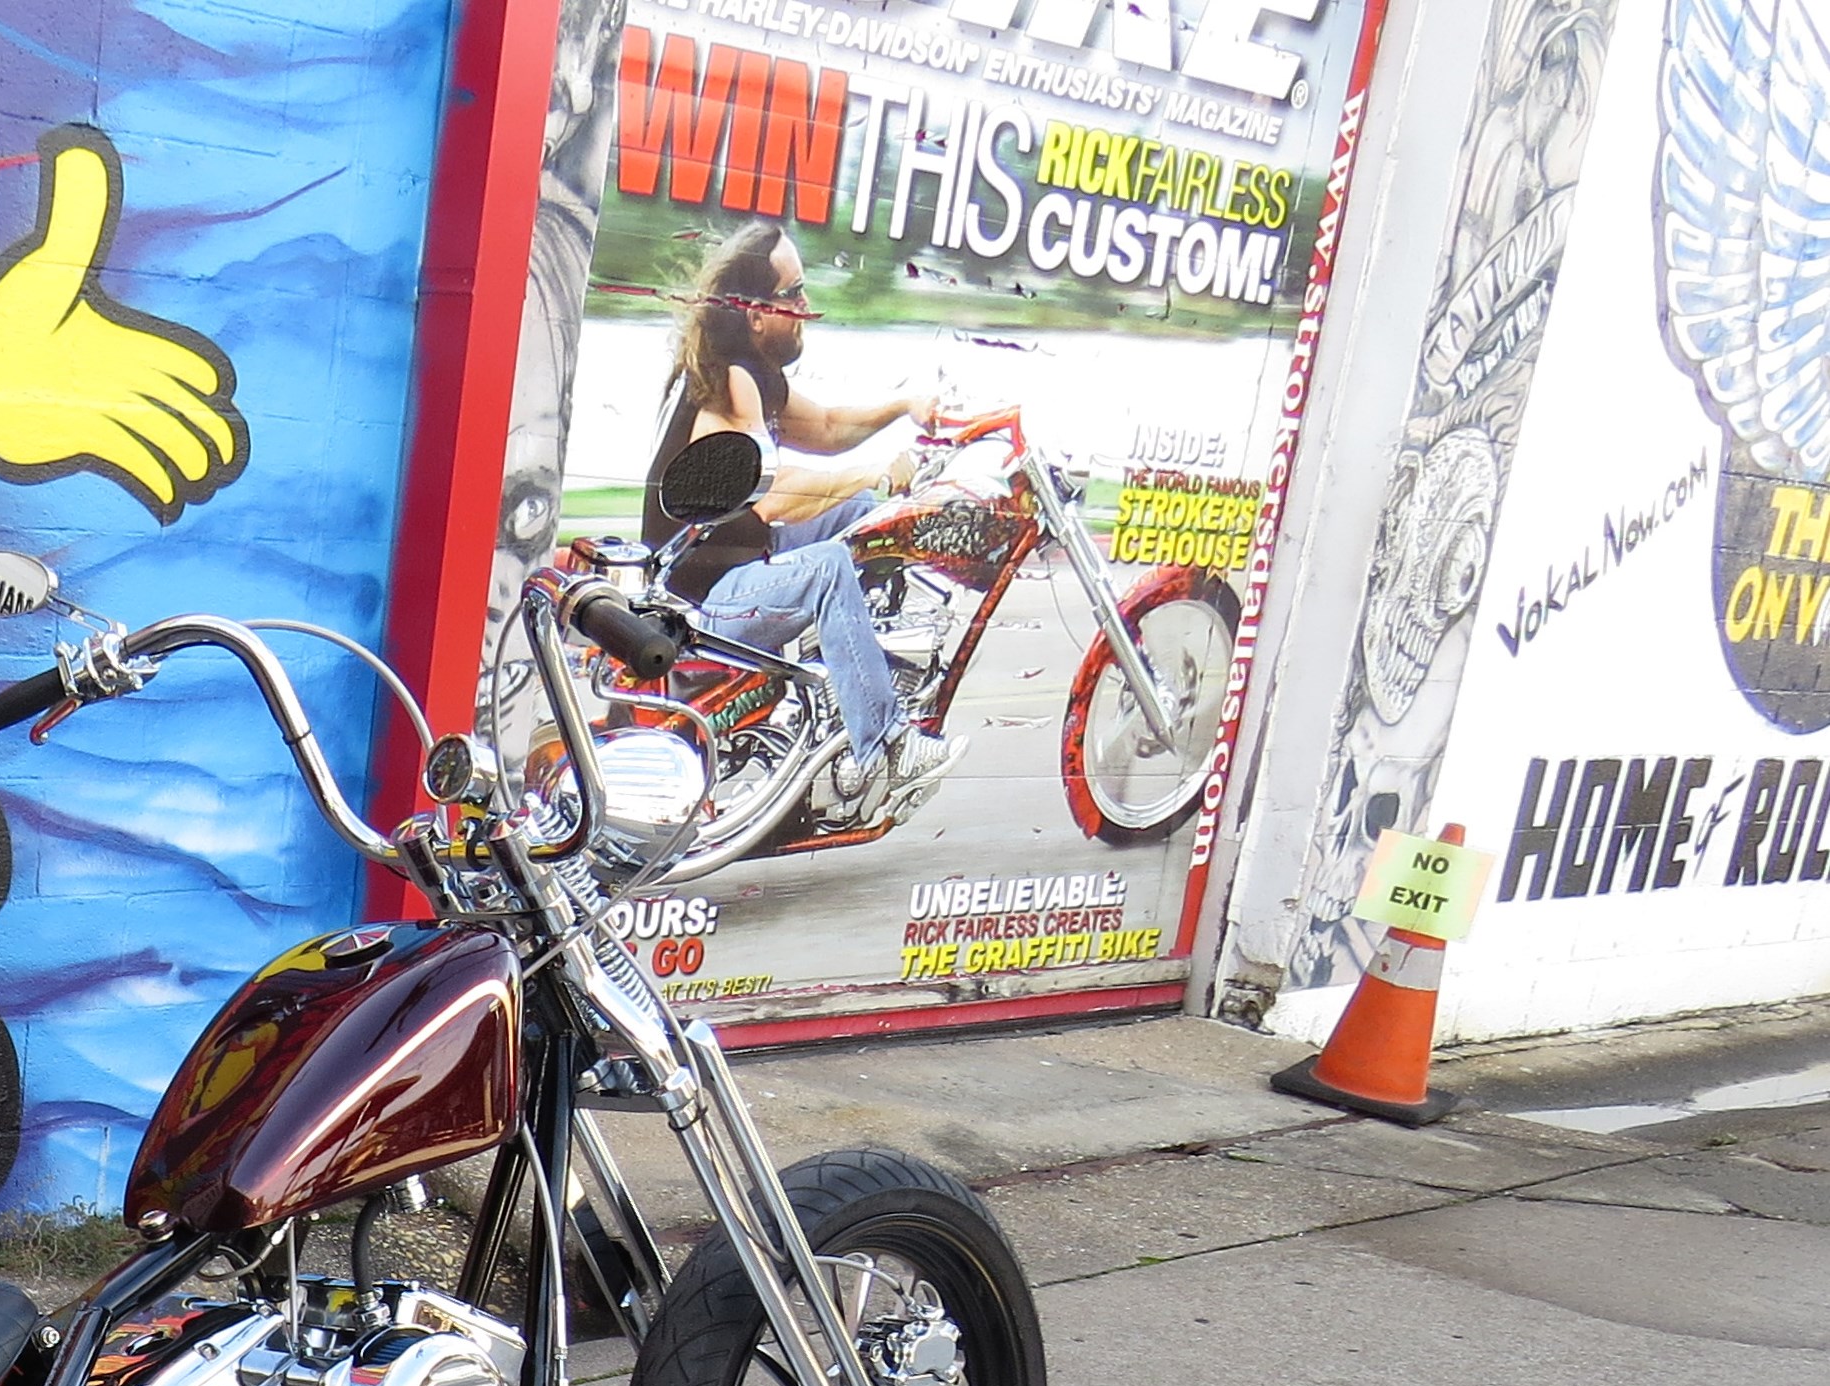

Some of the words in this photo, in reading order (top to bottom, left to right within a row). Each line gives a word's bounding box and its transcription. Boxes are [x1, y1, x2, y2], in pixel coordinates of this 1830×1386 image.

[983, 48, 1160, 115] ENTHUSIASTS'
[1162, 92, 1284, 146] MAGAZINE
[617, 24, 848, 224] WIN
[847, 72, 1033, 259] THIS
[1037, 120, 1142, 202] RICK
[1131, 141, 1291, 229] FAIRLESS
[1027, 192, 1282, 306] CUSTOM!
[1123, 466, 1149, 490] THE
[1154, 470, 1203, 495] WORLD
[1205, 474, 1262, 499] FAMOUS
[1190, 89, 1366, 869] www.strokersdallas.com
[1117, 488, 1258, 536] STROKERS
[1108, 526, 1253, 571] ICEHOUSE
[1495, 757, 1712, 903] HOME
[1412, 852, 1450, 875] NO
[910, 872, 1127, 920] UNBELIEVABLE:
[1389, 885, 1450, 914] EXIT
[903, 920, 951, 947] RICK
[953, 914, 1038, 944] FAIRLESS
[1043, 909, 1123, 935] CREATES
[652, 937, 706, 978] GO
[899, 943, 959, 980] THE
[964, 932, 1092, 974] GRAFFITI
[1098, 927, 1162, 961] BIKE
